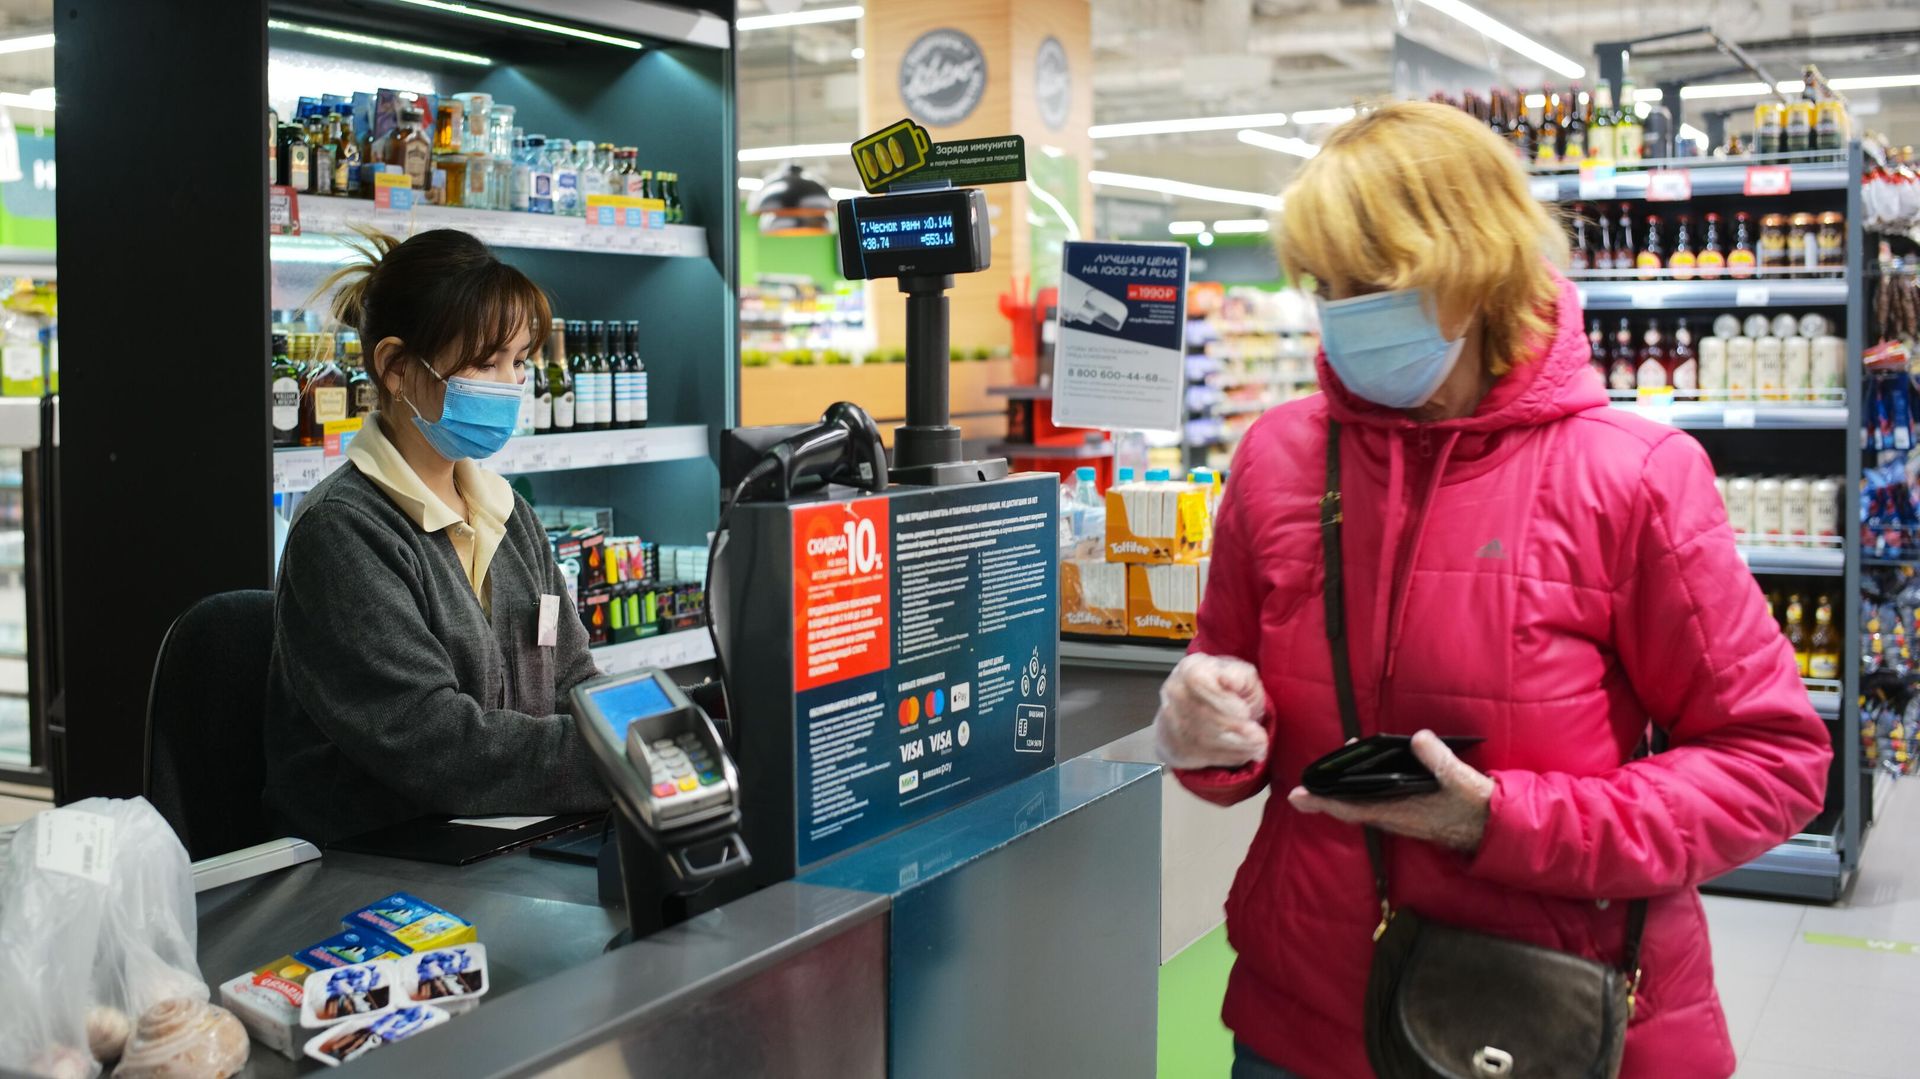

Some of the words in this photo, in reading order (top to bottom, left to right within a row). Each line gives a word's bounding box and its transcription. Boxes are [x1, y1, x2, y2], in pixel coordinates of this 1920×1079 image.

[935, 145, 969, 156] Заряди
[970, 140, 1018, 152] иммунитет
[935, 157, 959, 167] получай
[960, 156, 985, 165] подарки
[994, 154, 1019, 162] покупки
[860, 221, 898, 234] 7.Чеснок
[1094, 254, 1144, 266] ЛУЧШАЯ
[1146, 256, 1178, 267] ЦЕНА
[1082, 265, 1098, 274] НА
[1100, 266, 1128, 276] IQOS
[1148, 267, 1178, 279] PLUS
[1077, 368, 1097, 378] 800
[807, 533, 848, 556] СКИДКА
[929, 729, 952, 753] VISA
[899, 739, 924, 763] VISA
